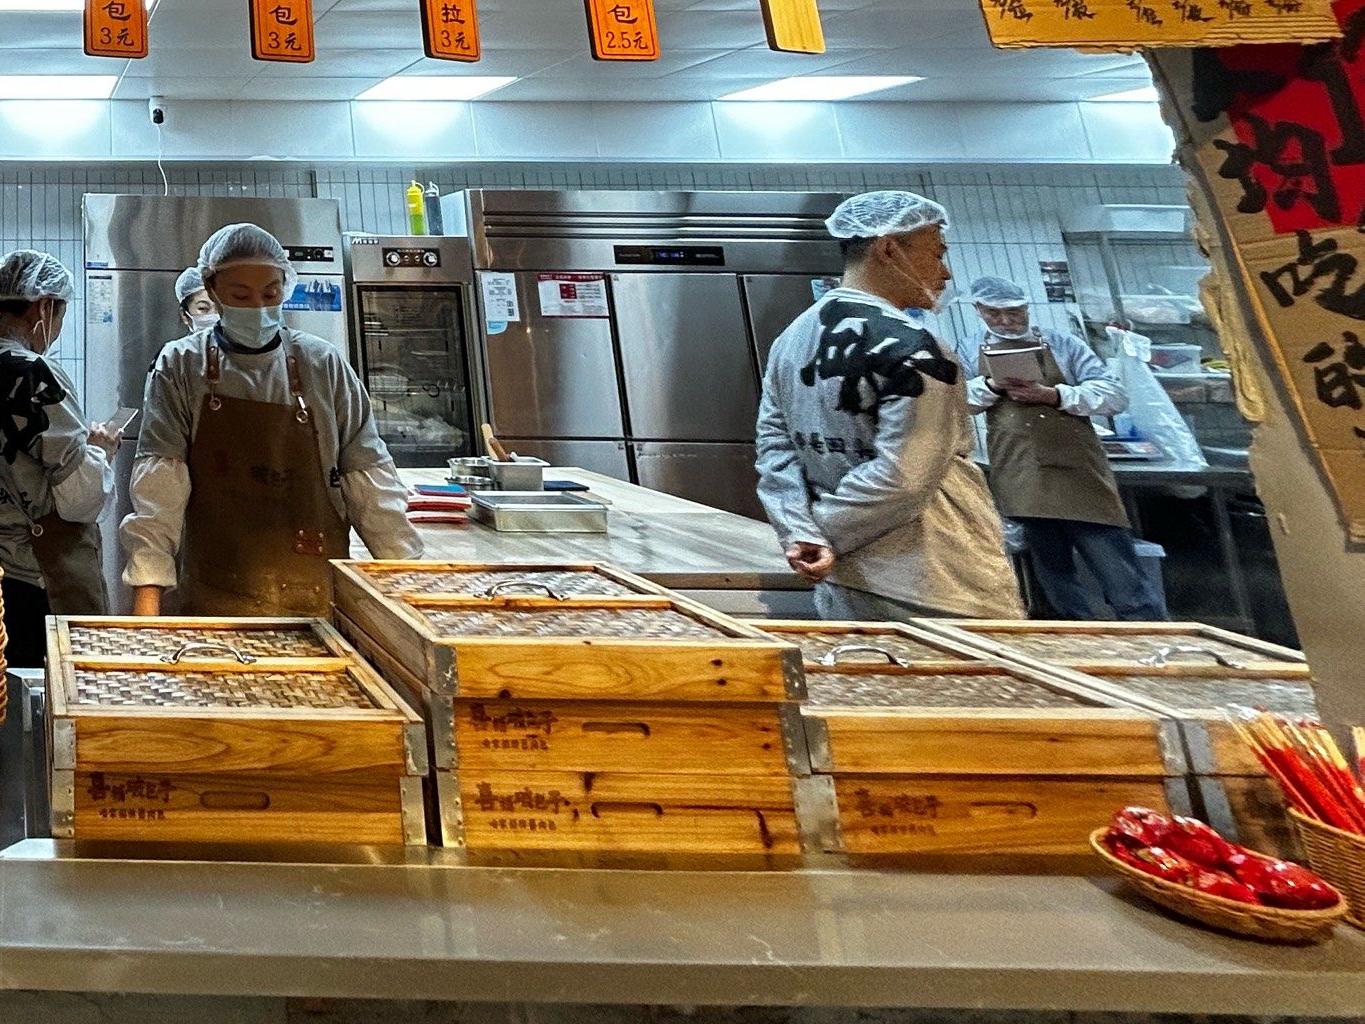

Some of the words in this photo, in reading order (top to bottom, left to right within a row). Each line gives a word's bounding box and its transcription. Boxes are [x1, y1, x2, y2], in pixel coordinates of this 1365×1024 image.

[100, 26, 135, 47] 3元
[268, 31, 302, 52] 3元
[441, 30, 470, 51] 3元
[605, 32, 648, 51] 2.5元
